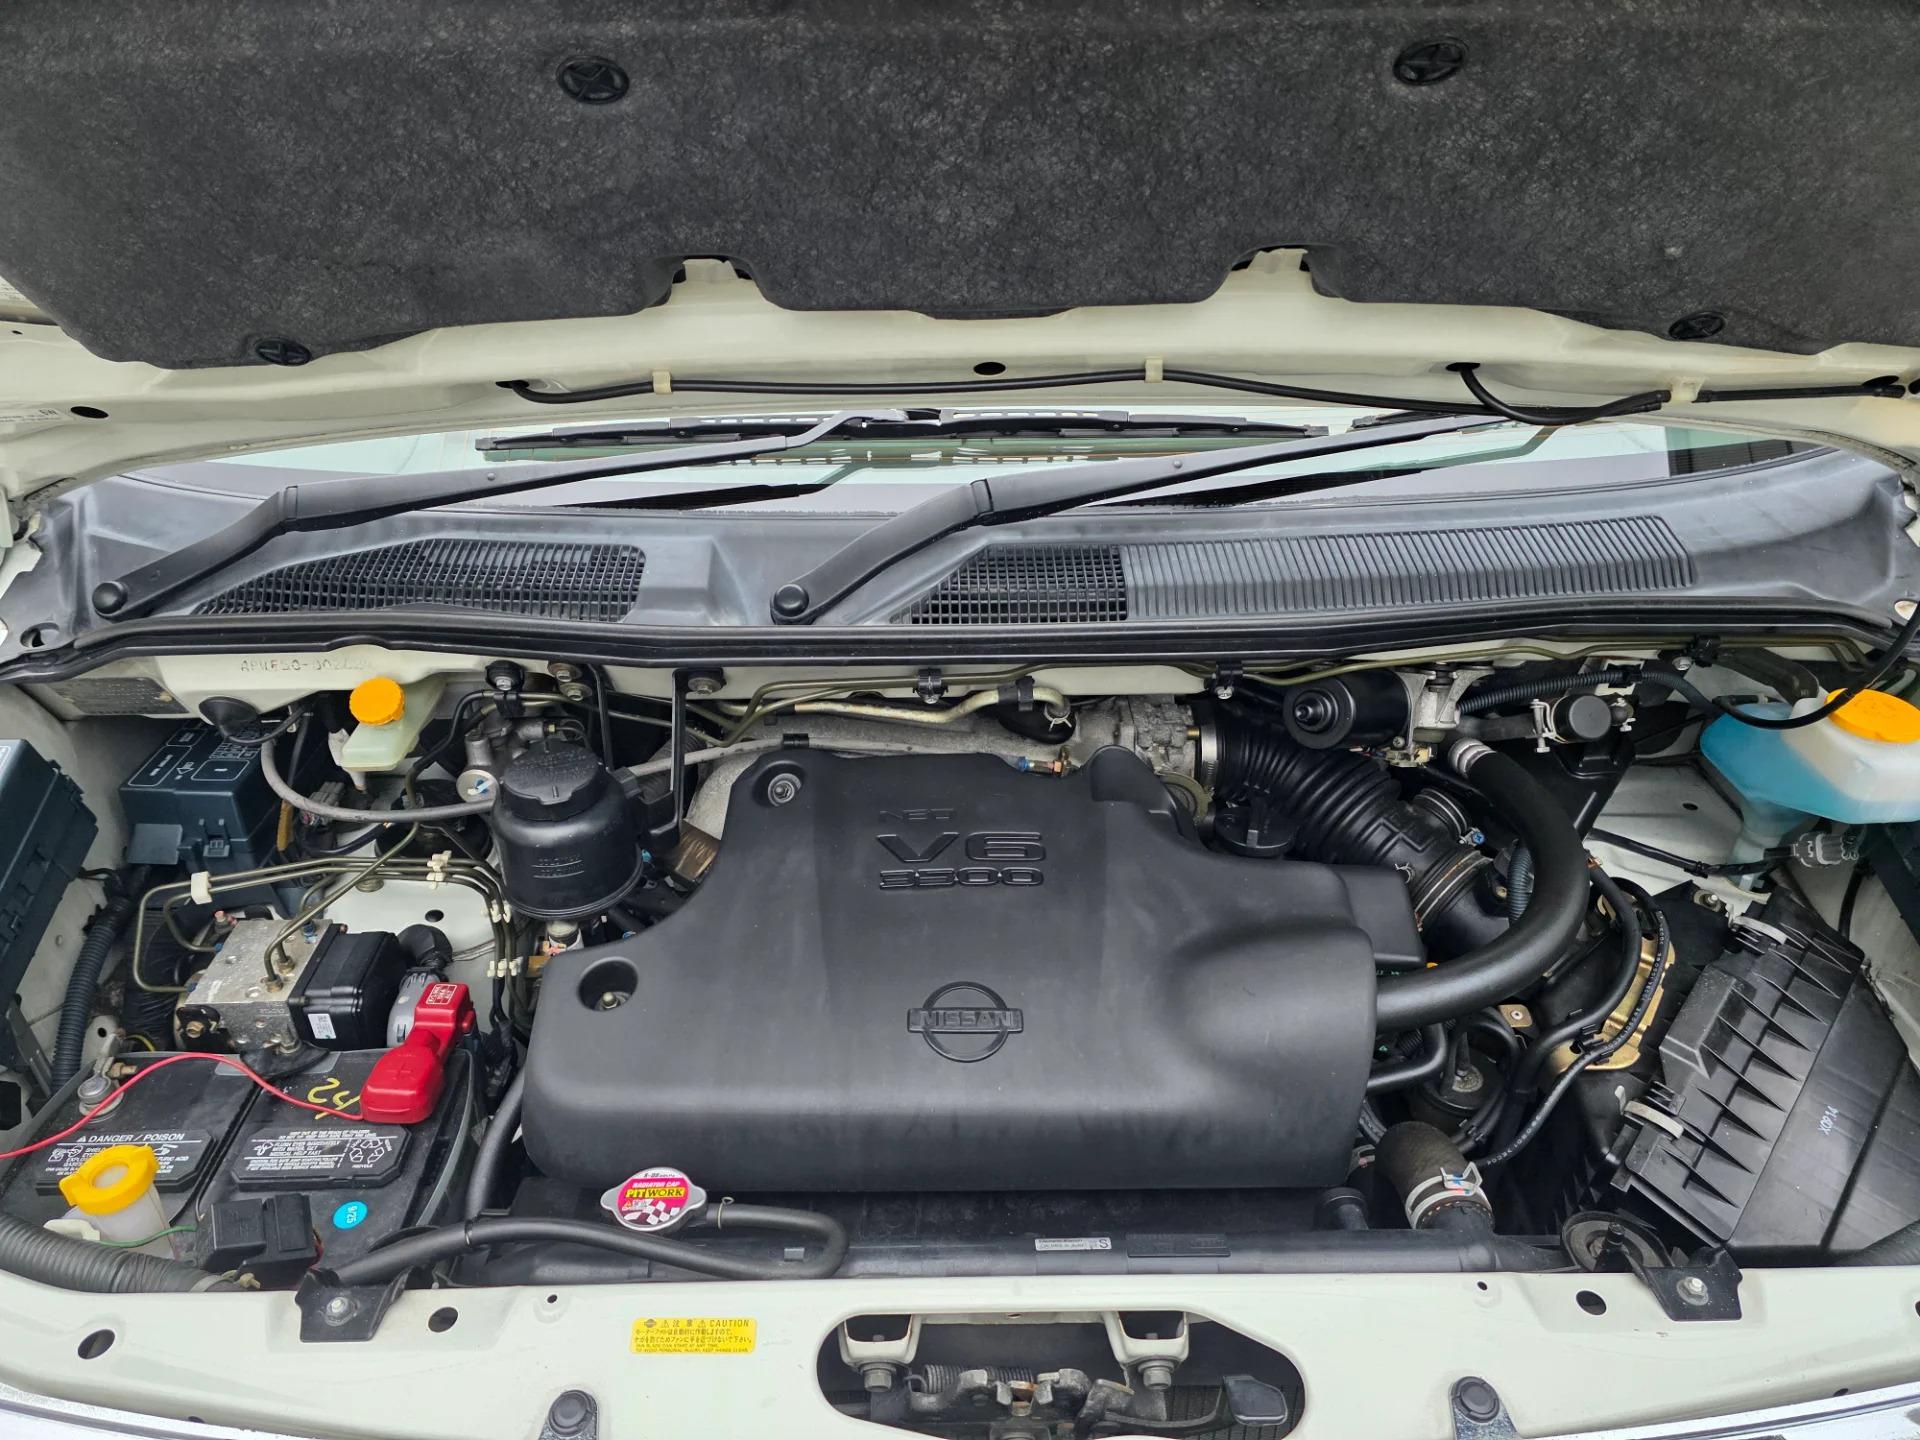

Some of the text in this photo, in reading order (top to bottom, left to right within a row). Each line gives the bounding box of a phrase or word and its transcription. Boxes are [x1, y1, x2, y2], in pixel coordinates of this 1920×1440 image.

[875, 831, 1047, 863] V6
[879, 867, 1044, 890] 3500
[919, 1010, 1014, 1028] NISSAN
[88, 1134, 134, 1142] DANGER
[143, 1133, 185, 1141] POISON
[709, 1319, 749, 1328] CAUTION
